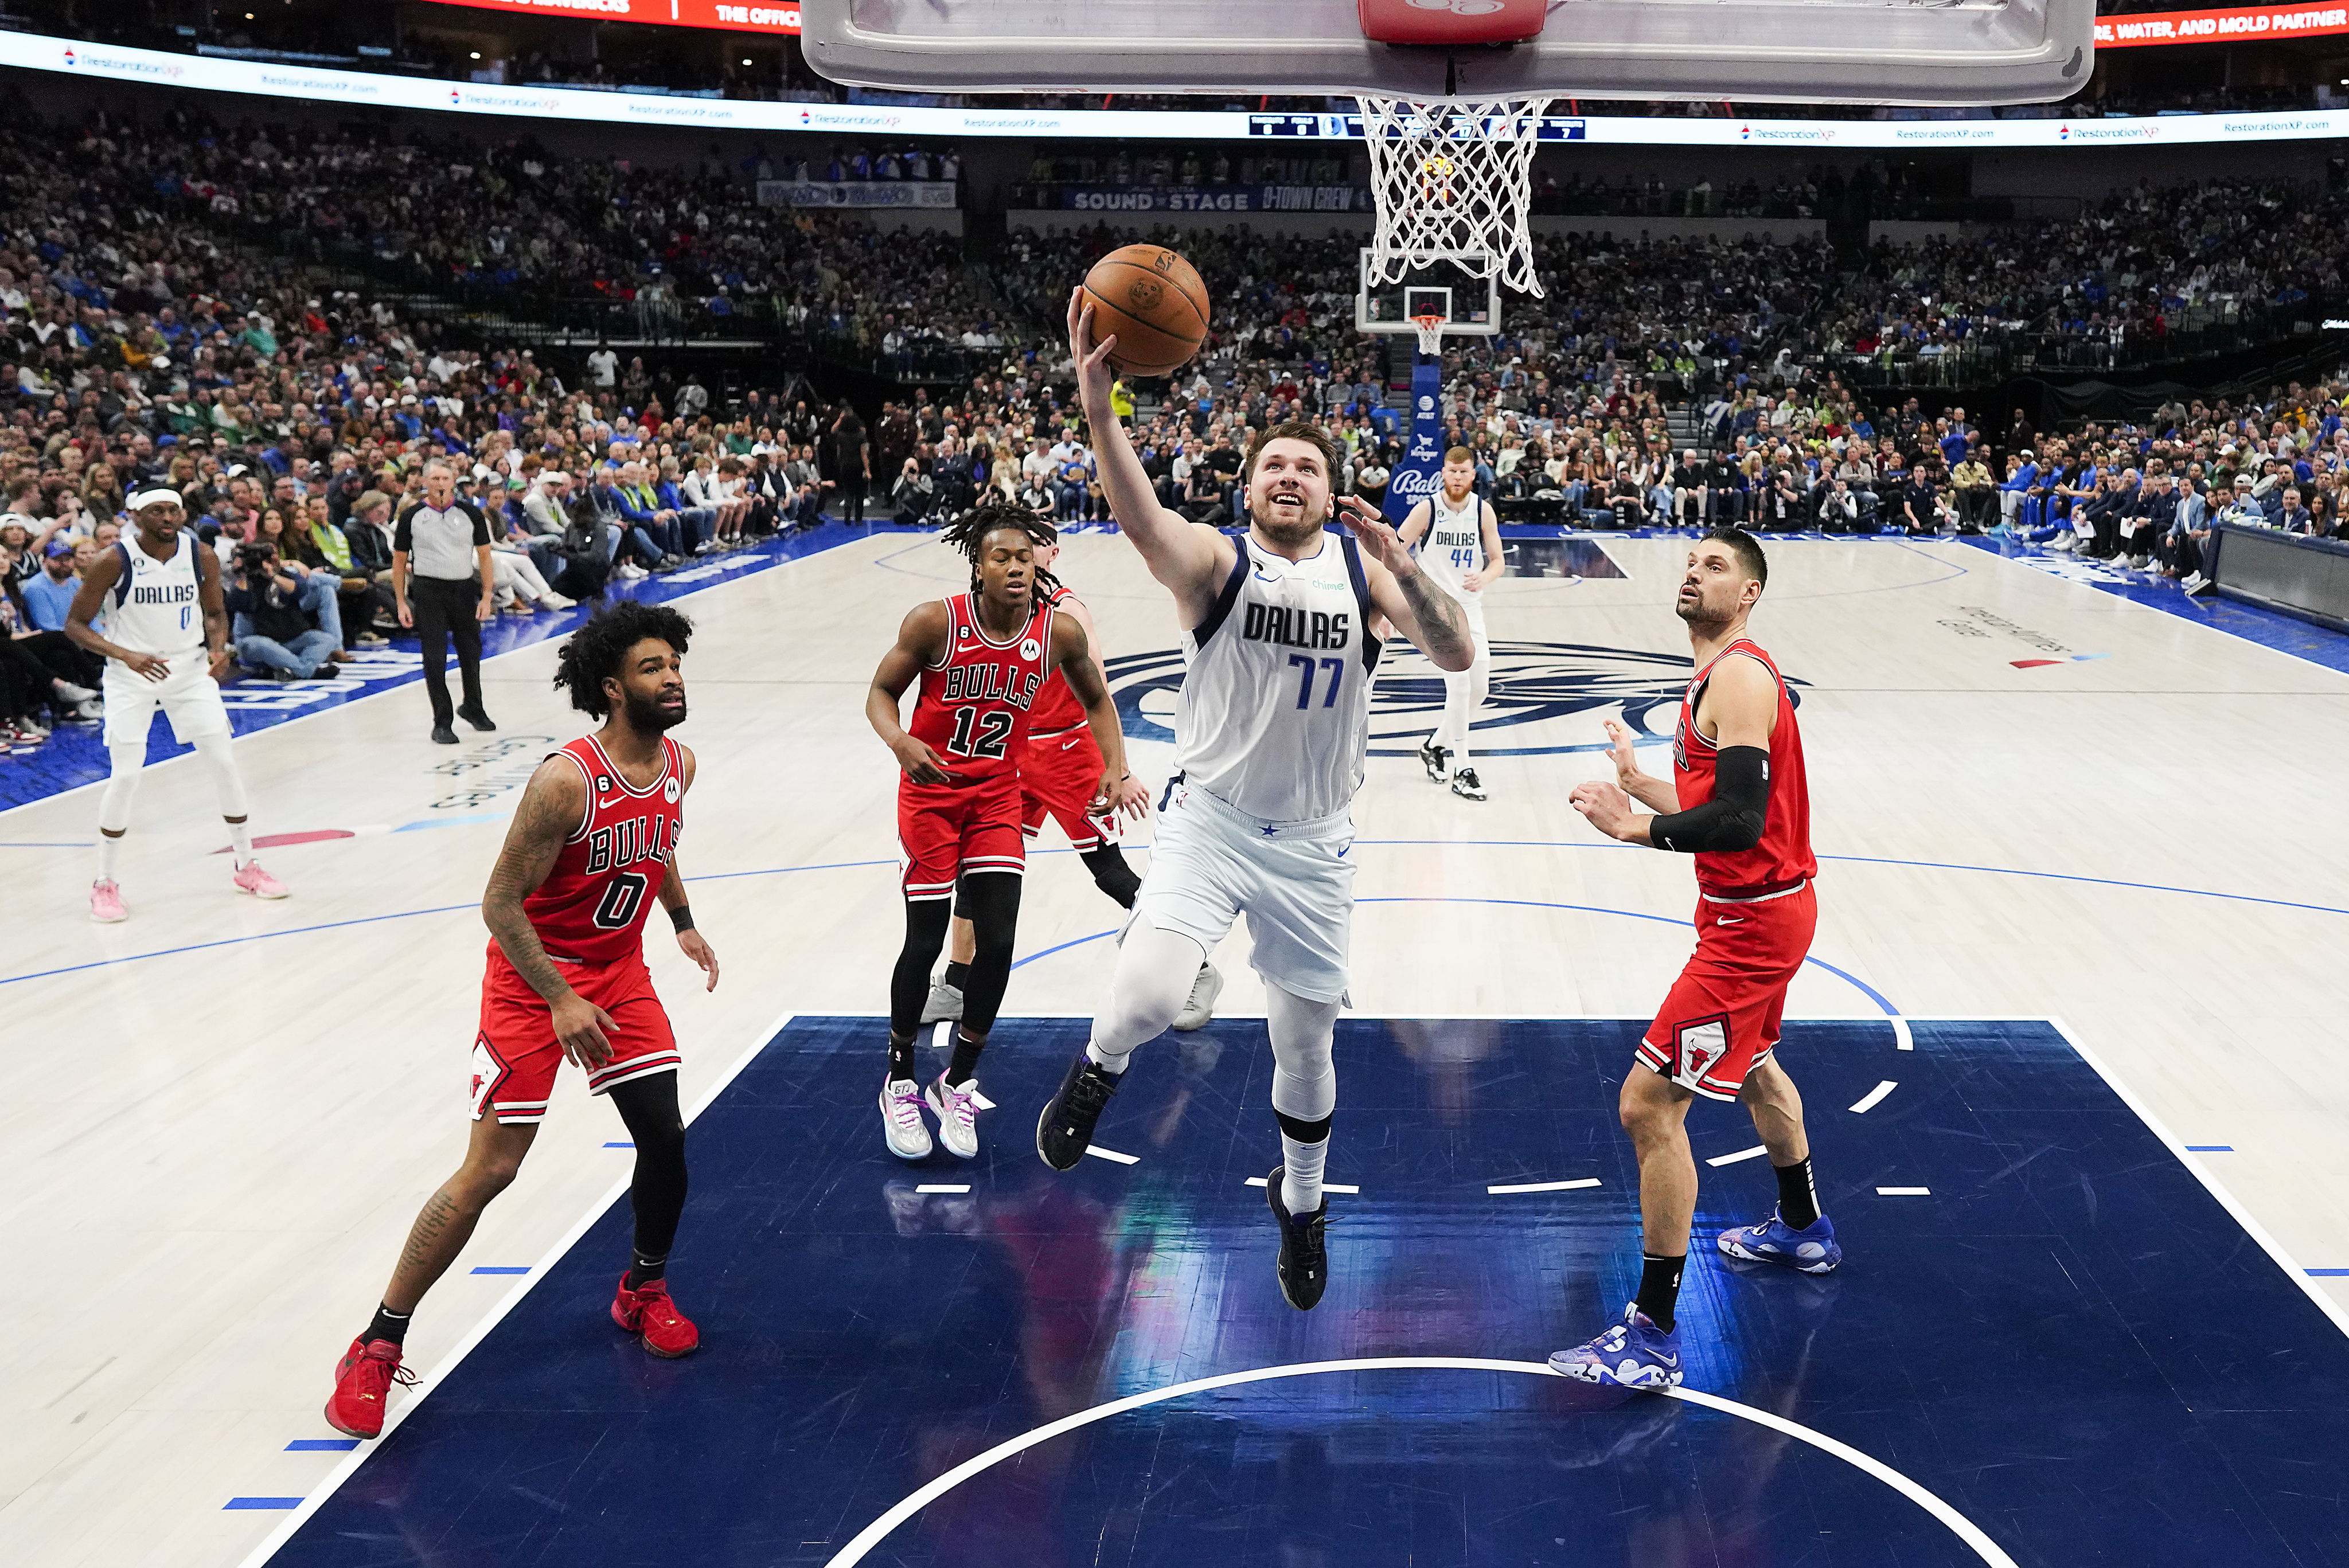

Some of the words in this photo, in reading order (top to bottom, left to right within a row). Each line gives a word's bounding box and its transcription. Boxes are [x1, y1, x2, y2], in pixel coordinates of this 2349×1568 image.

[715, 5, 749, 22] THE
[750, 7, 801, 27] OFFICI
[2094, 25, 2114, 41] RE,
[2117, 21, 2176, 38] WATER,
[2178, 19, 2217, 35] AND
[2218, 16, 2270, 33] MOLD
[2272, 9, 2347, 31] PARTNER
[1562, 128, 1570, 138] 7
[1755, 128, 1835, 140] RestorationXP
[1897, 130, 1994, 139] RestorationXP.com
[2074, 125, 2159, 139] RestorationXP
[2225, 121, 2329, 132] RestorationXP.com
[1075, 193, 1153, 210] SOUND
[1169, 193, 1248, 210] STAGE
[1392, 470, 1445, 494] Ball
[1437, 531, 1475, 546] DALLAS
[1450, 549, 1473, 568] 44
[135, 584, 194, 604] DALLAS
[1312, 579, 1345, 591] chime
[181, 607, 191, 630] 0
[1242, 601, 1349, 650] DALLAS
[959, 626, 969, 638] 6
[942, 663, 1040, 711] BULLS
[1287, 653, 1344, 710] 77
[947, 706, 1014, 760] 12
[598, 776, 609, 792] 6
[586, 814, 681, 875] BULLS
[592, 872, 648, 929] 0
